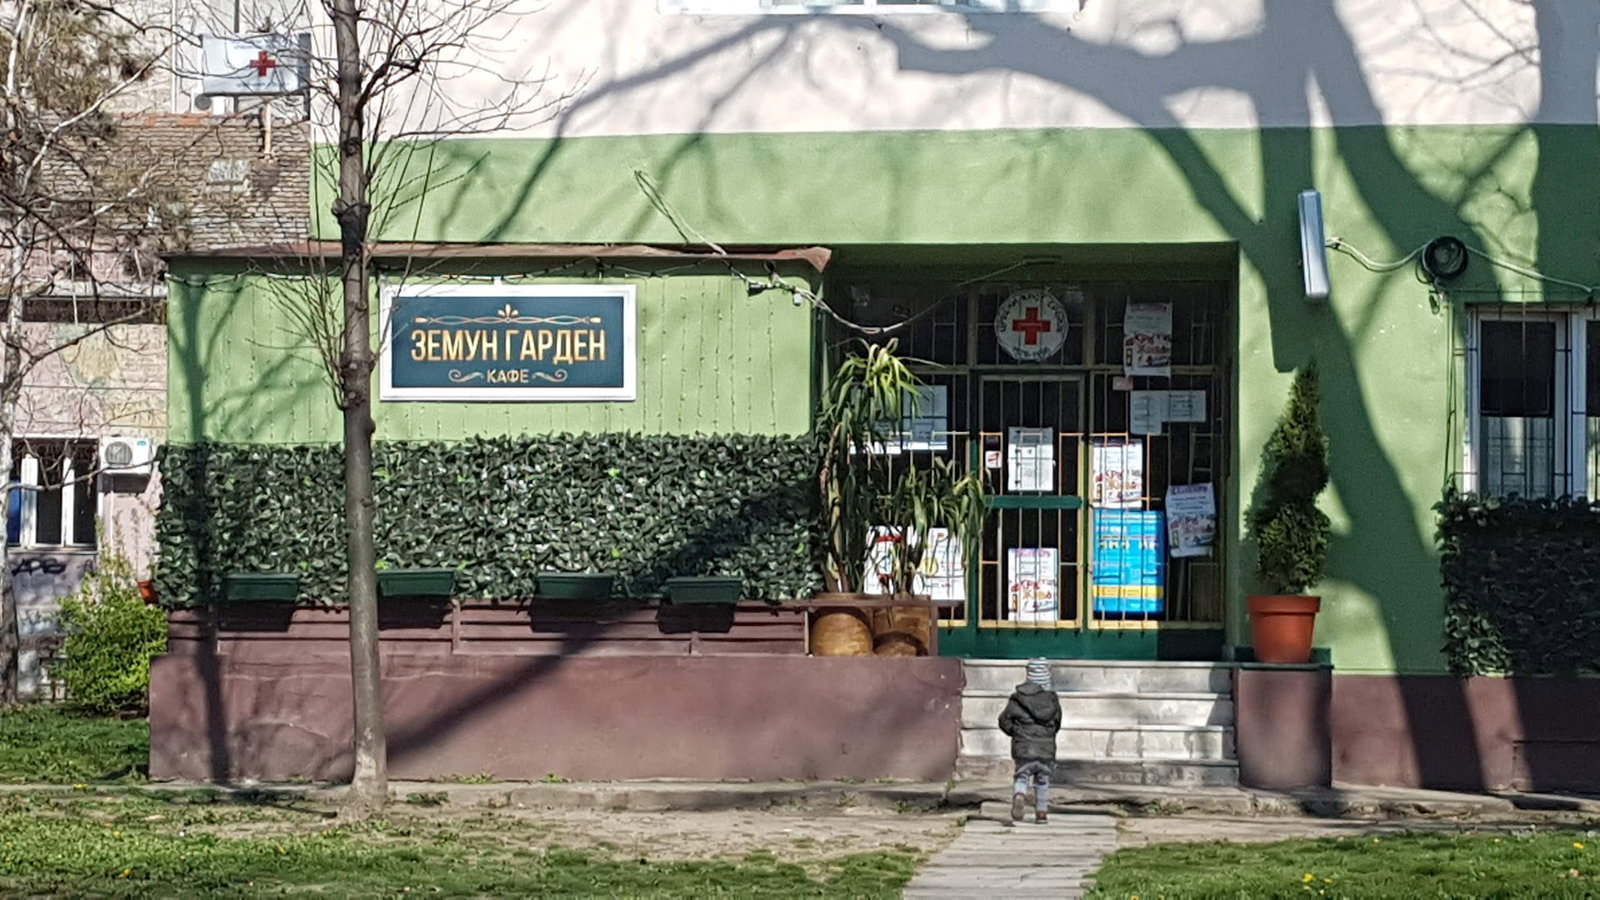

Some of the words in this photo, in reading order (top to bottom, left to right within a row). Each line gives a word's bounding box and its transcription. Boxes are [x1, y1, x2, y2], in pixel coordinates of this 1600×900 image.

[411, 329, 498, 361] ЗЕМУН
[505, 329, 605, 365] ГАРДЕН
[486, 368, 529, 383] КАФЕ
